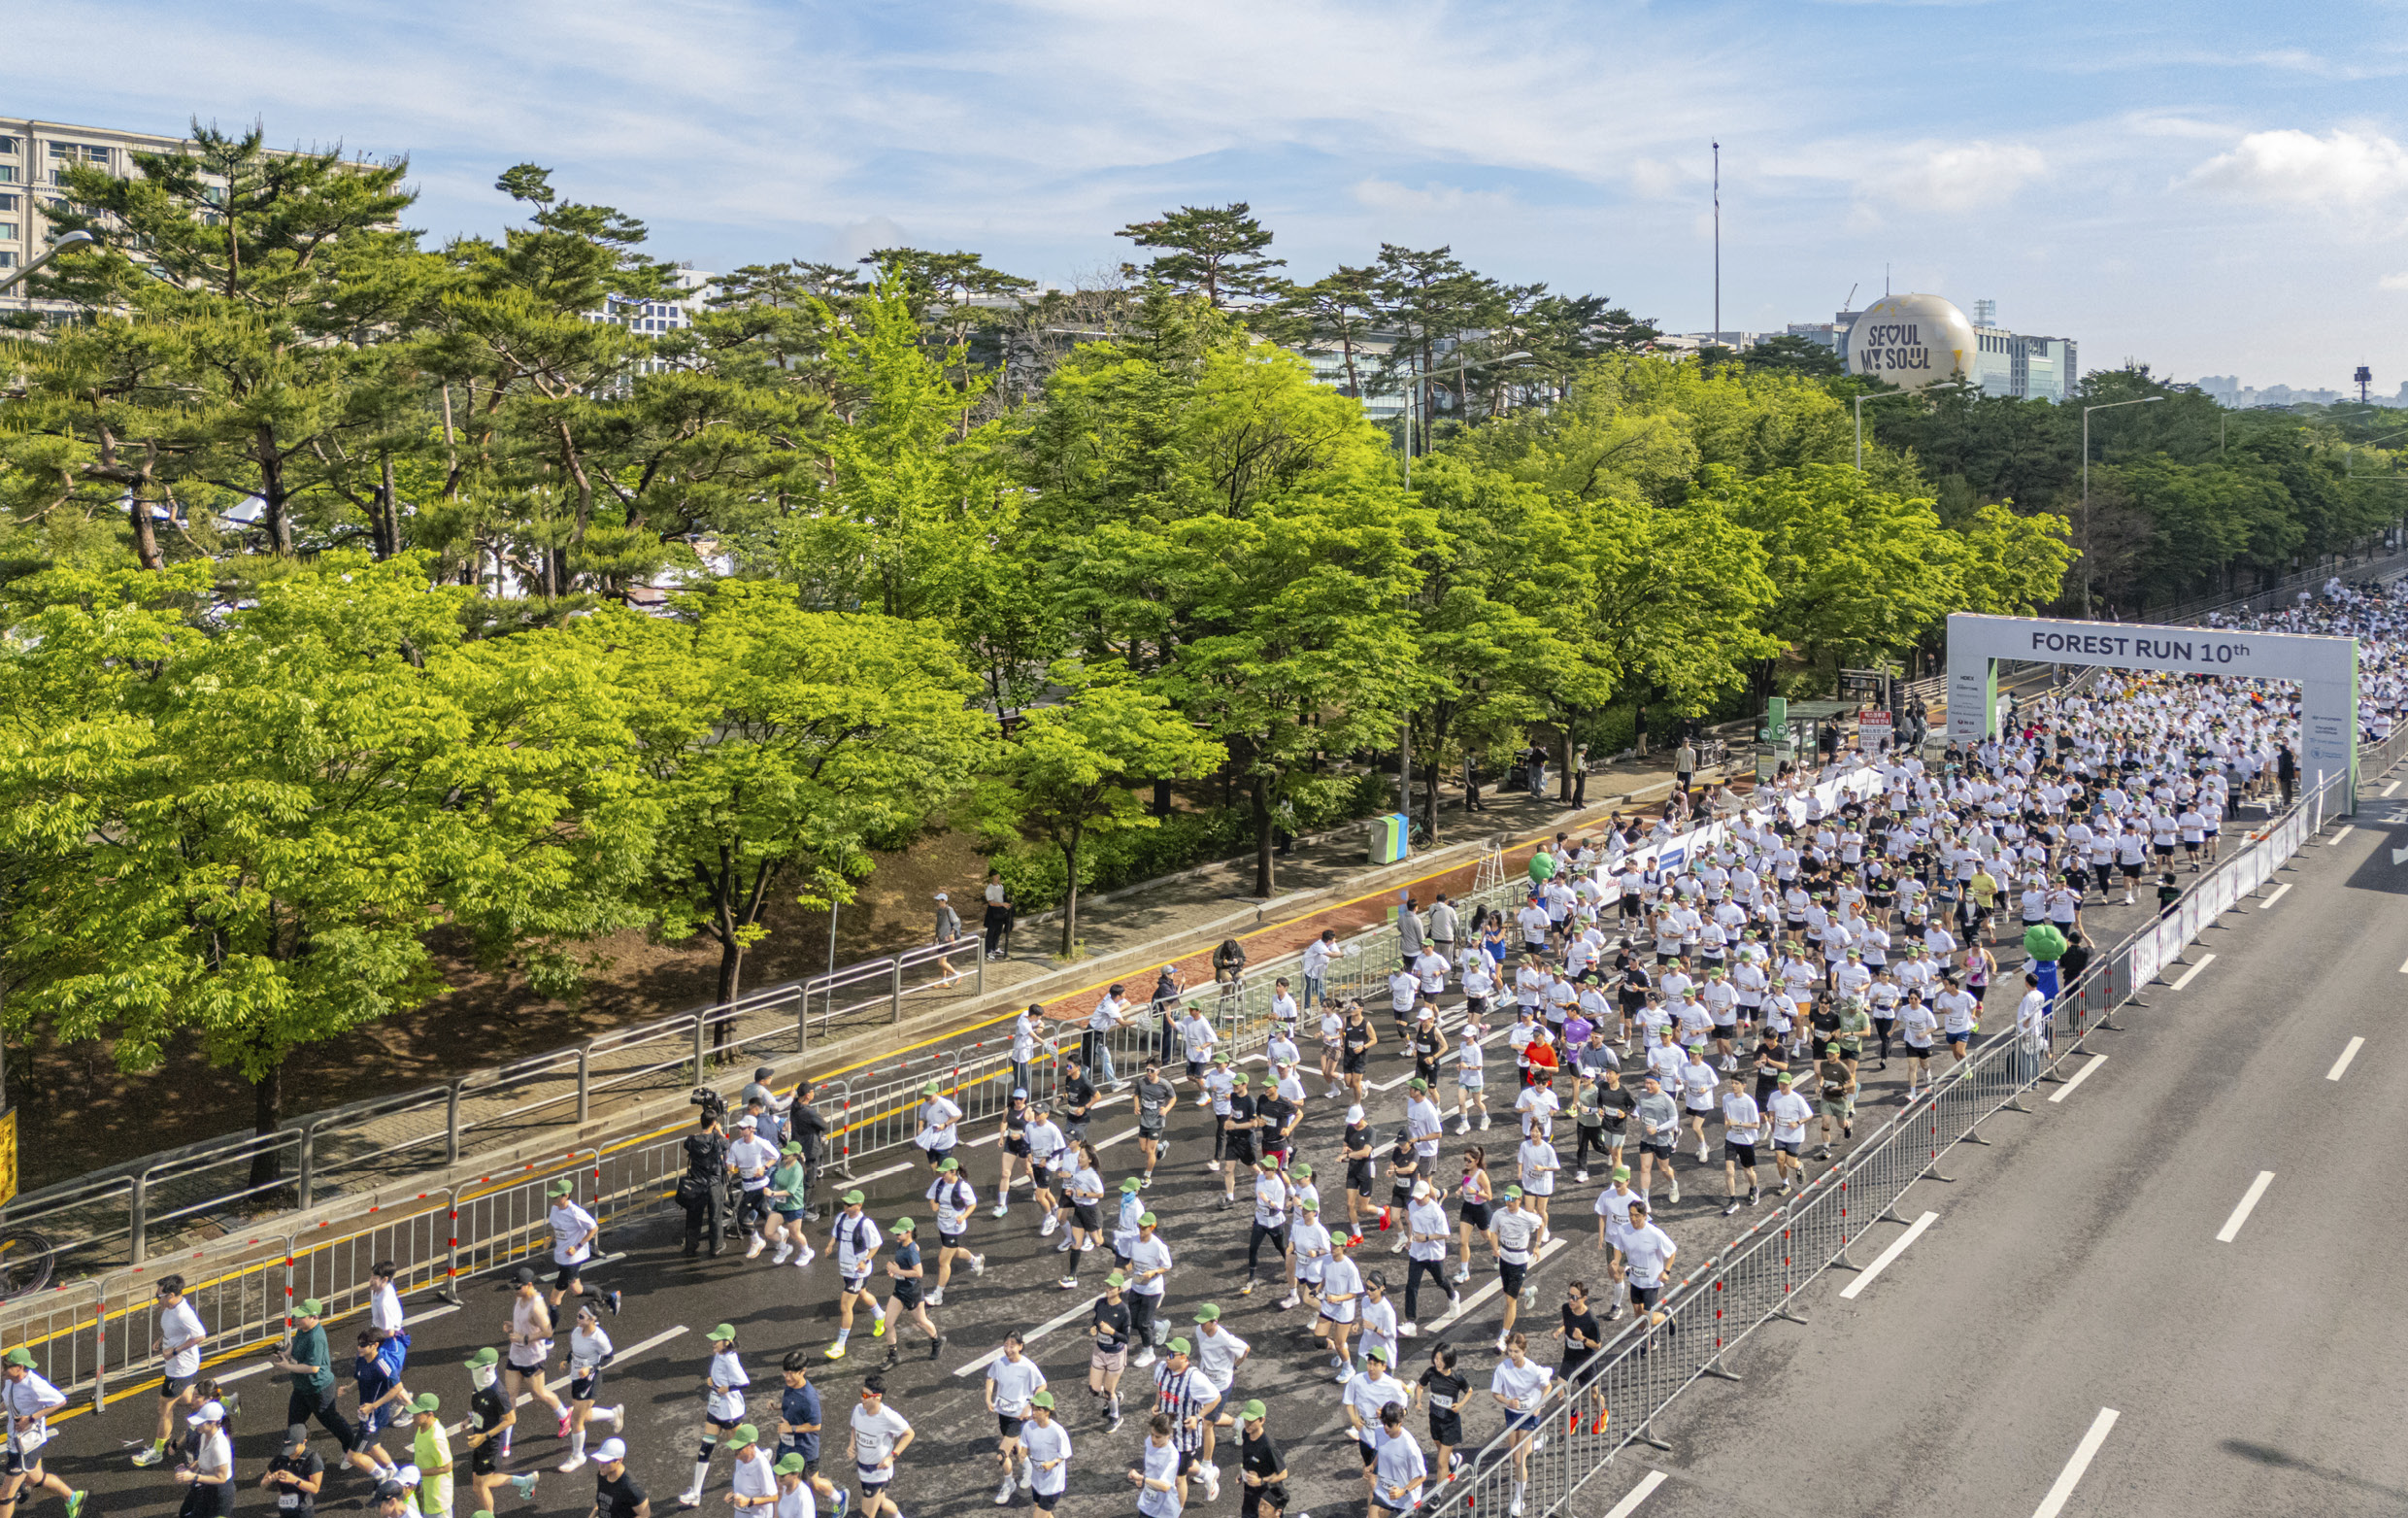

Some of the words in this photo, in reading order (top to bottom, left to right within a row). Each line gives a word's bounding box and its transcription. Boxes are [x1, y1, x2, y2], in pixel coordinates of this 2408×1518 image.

[1886, 348, 1931, 370] SOUL
[2032, 632, 2129, 656] FOREST
[2136, 639, 2192, 660] RUN
[2200, 643, 2251, 663] 10th
